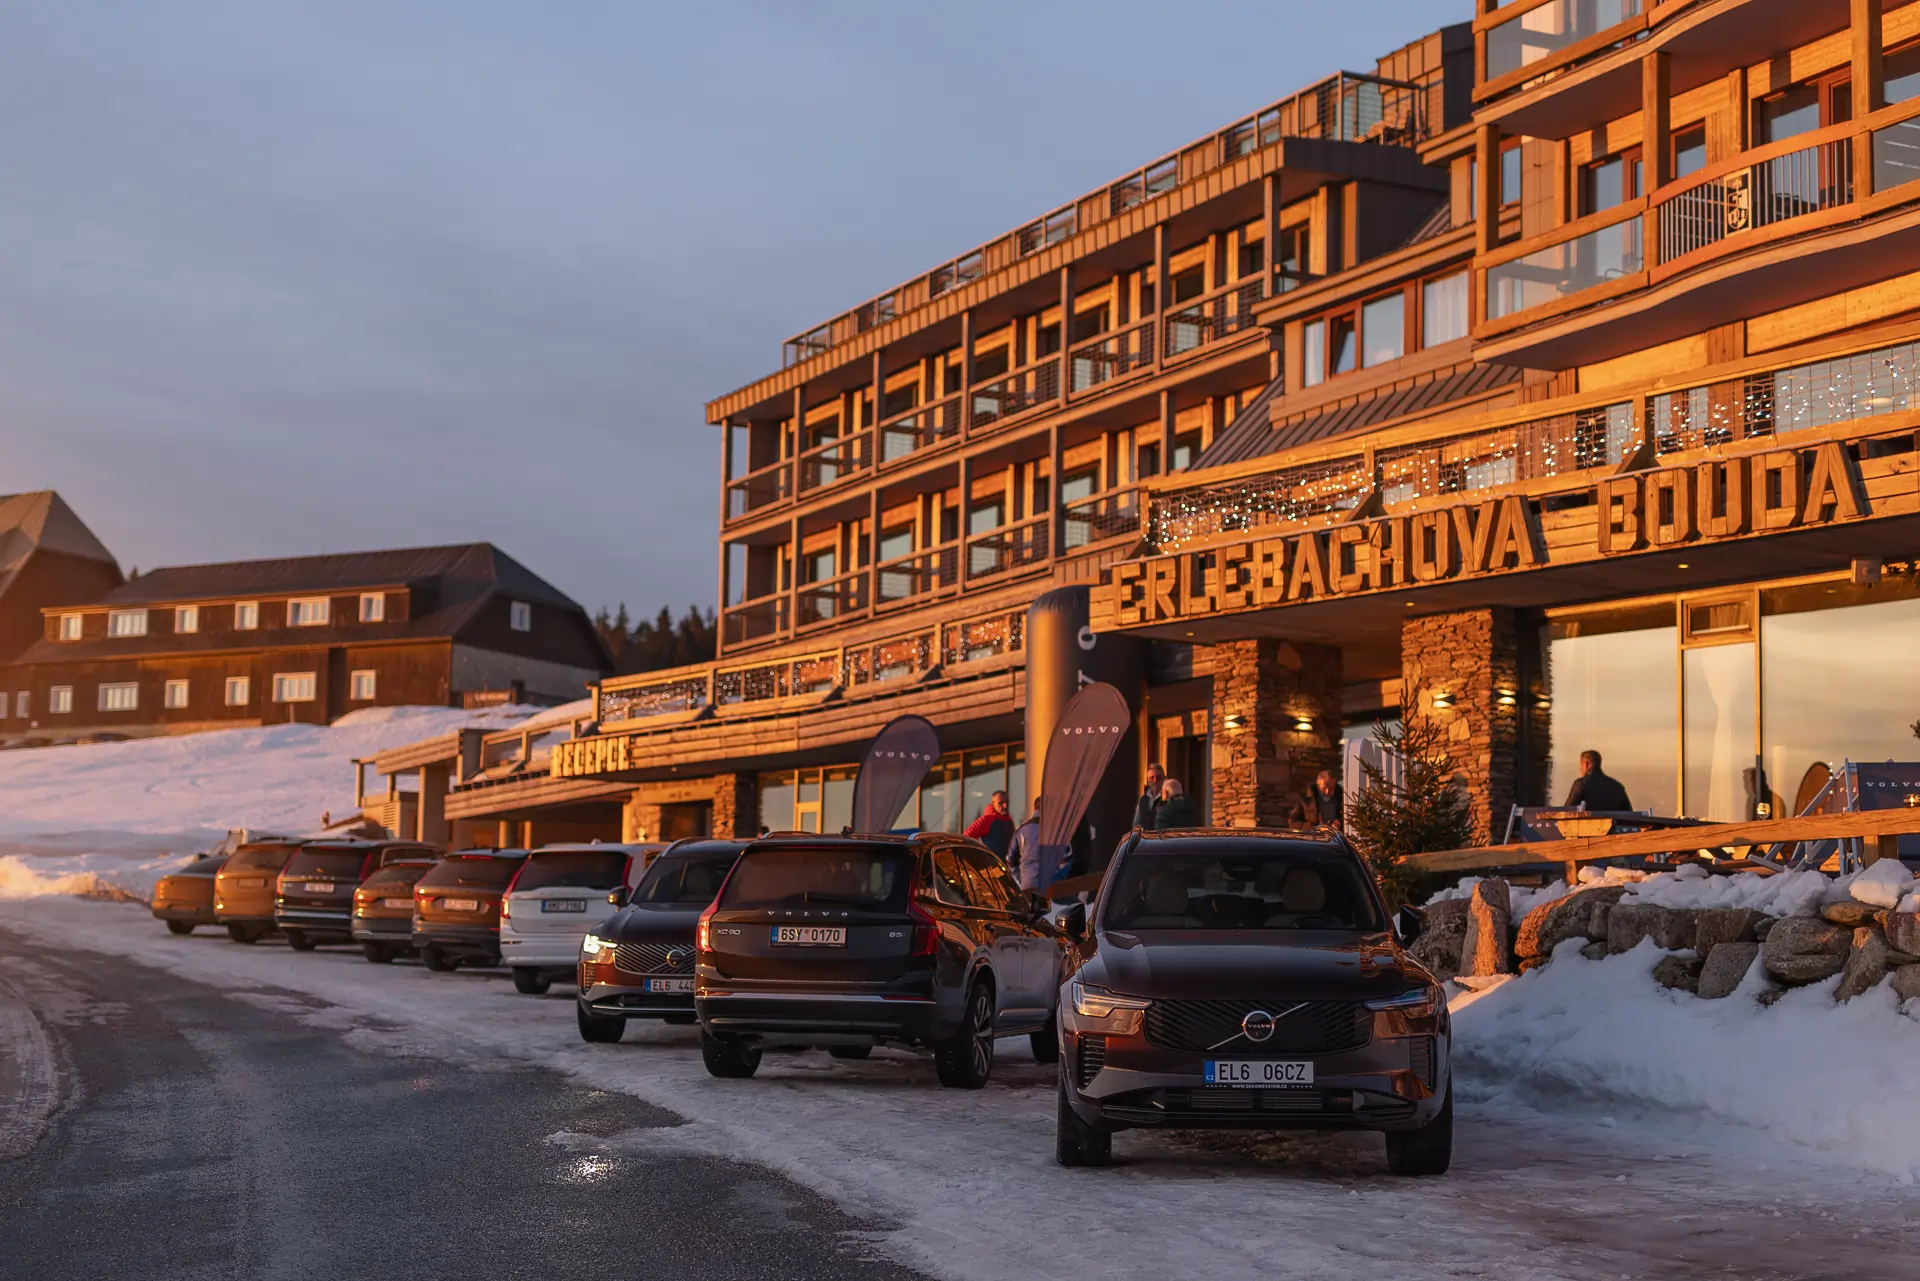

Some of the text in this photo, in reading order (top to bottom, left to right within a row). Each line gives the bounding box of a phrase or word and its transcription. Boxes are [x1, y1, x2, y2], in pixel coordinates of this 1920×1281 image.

[1112, 440, 1866, 624] ERLEBACHOVA BOUDA
[1063, 726, 1119, 735] VOLVO
[551, 736, 629, 777] RECEPCE
[875, 751, 930, 761] VOLVO
[781, 928, 840, 942] 6SY 0170
[653, 981, 670, 991] EL6
[1219, 1064, 1305, 1080] EL6 06CZ
